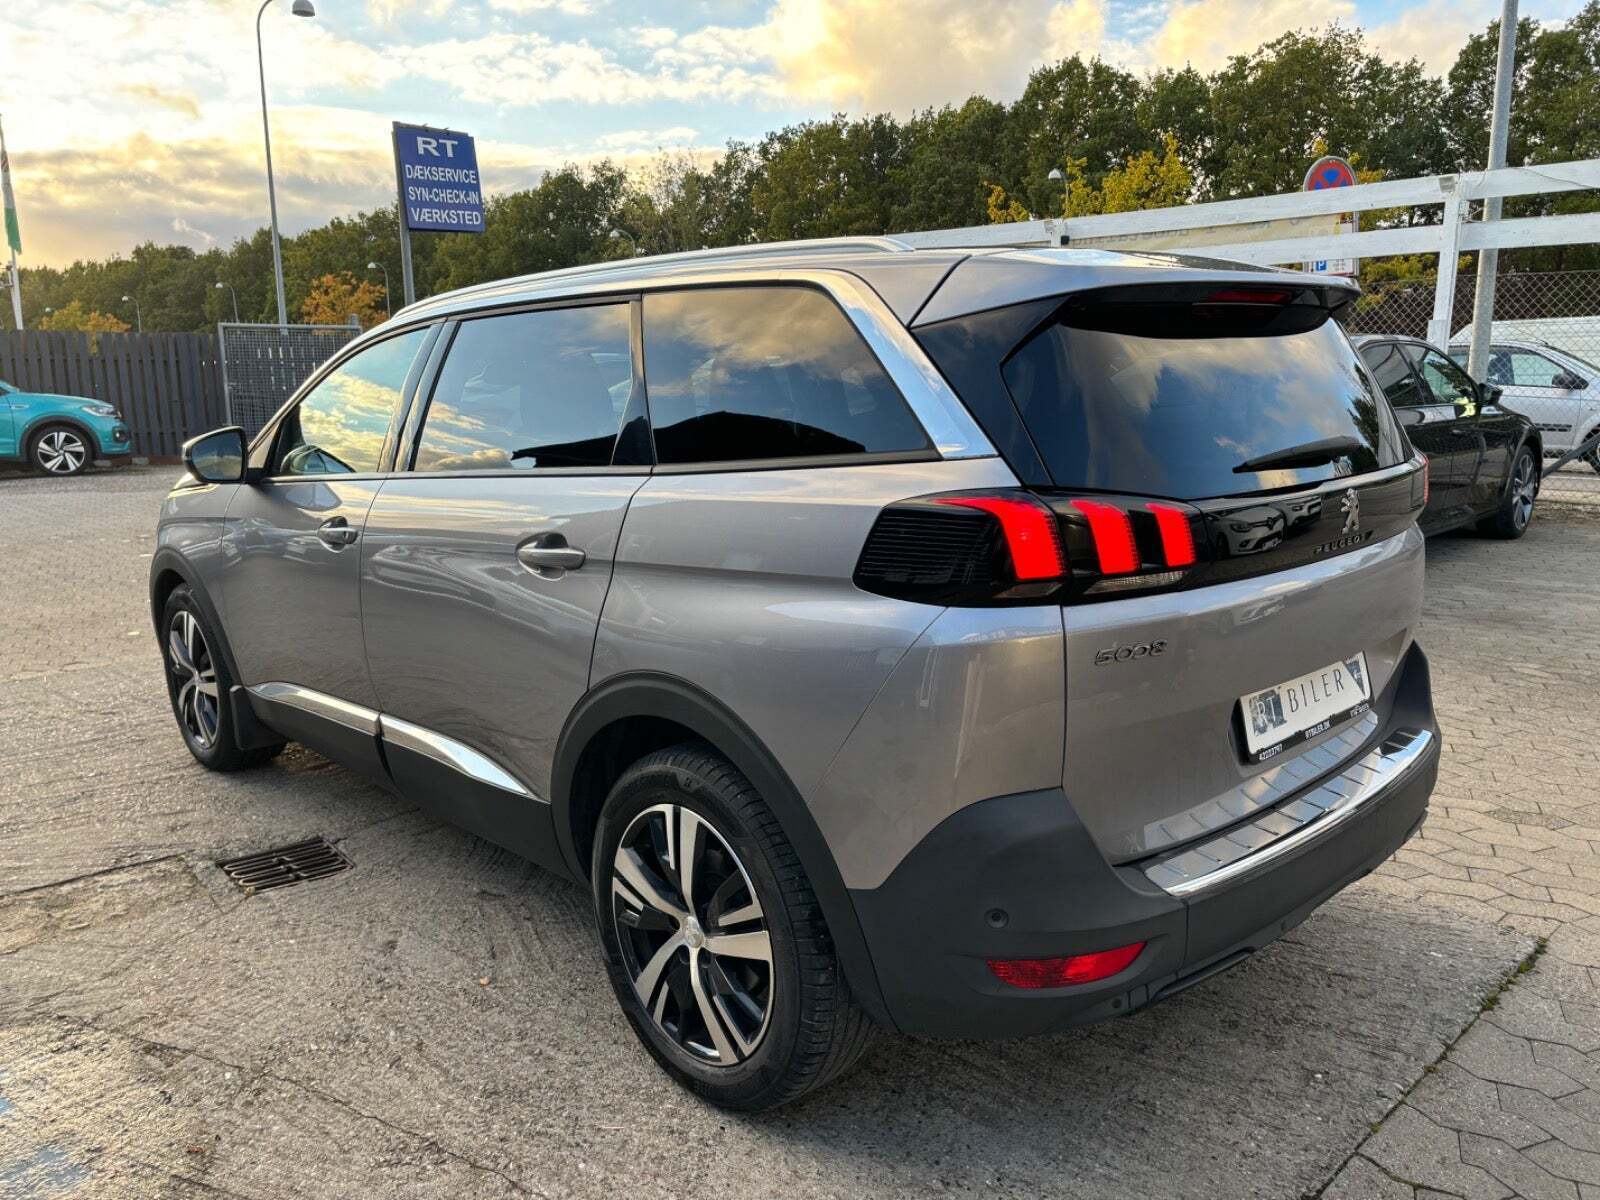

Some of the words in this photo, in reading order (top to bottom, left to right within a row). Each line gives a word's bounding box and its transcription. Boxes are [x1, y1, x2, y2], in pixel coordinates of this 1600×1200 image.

[416, 136, 458, 158] RT
[405, 164, 477, 184] DÆKSERVICE
[408, 186, 479, 205] SYN-CHECK-IN
[411, 207, 481, 225] VÆRKSTED
[1094, 639, 1168, 666] 5008
[1287, 668, 1345, 713] BILER
